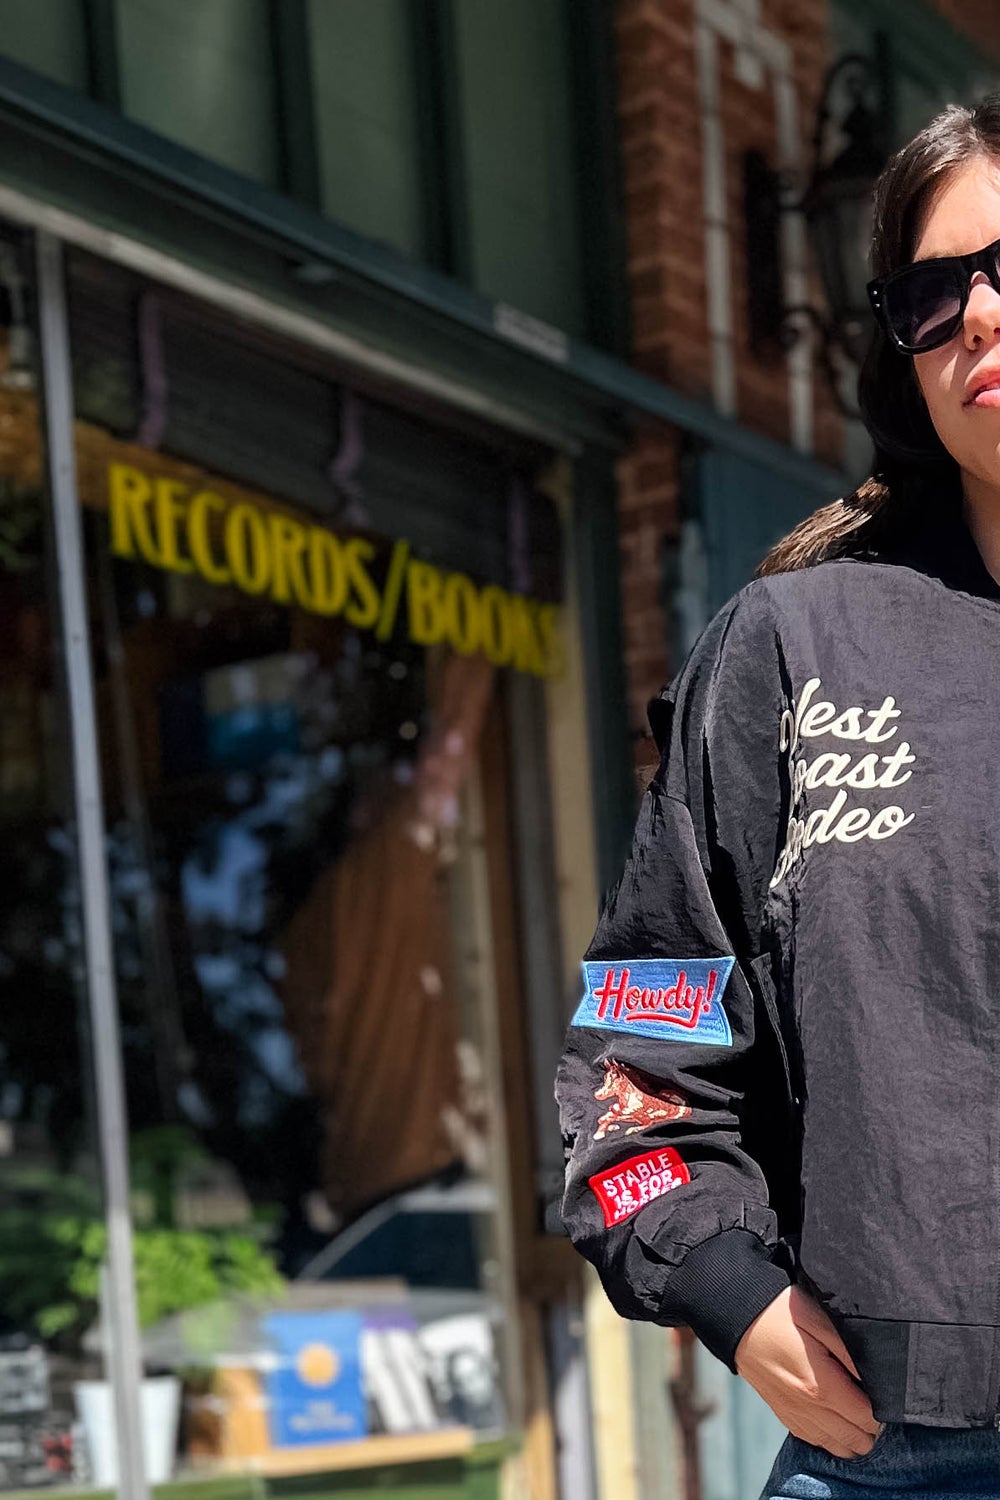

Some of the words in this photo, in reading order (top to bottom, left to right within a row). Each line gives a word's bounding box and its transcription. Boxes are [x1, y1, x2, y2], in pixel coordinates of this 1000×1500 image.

[593, 967, 718, 1029] Howdy!
[602, 1152, 673, 1197] STABLE
[613, 1189, 634, 1210] IS
[638, 1169, 673, 1197] FOR
